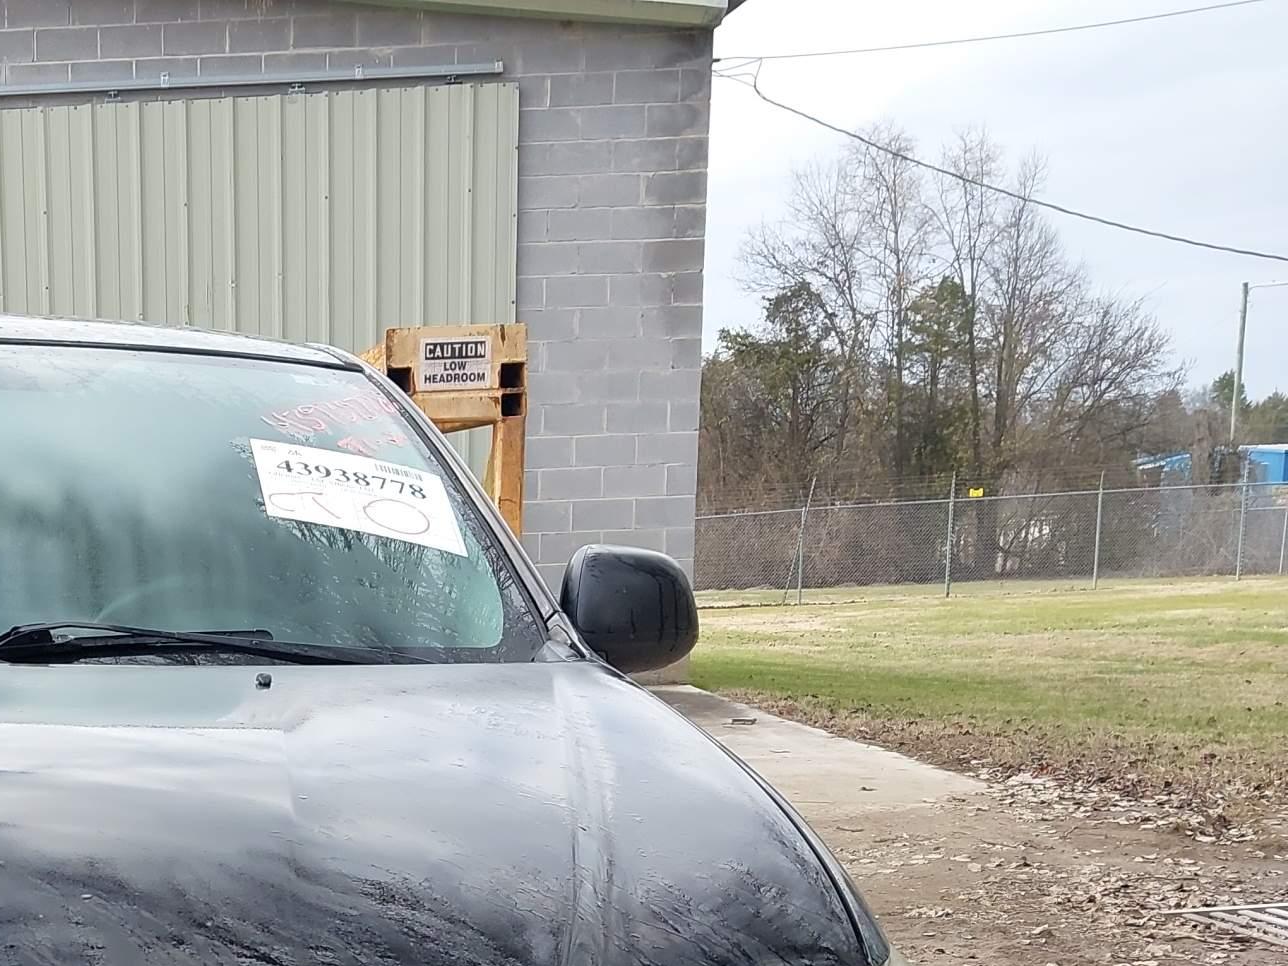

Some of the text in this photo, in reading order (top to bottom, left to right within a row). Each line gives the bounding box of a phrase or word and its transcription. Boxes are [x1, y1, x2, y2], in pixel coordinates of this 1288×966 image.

[425, 342, 486, 358] CAUTION
[443, 360, 468, 372] LOW
[423, 372, 486, 384] HEADROOM
[276, 459, 428, 500] 43938778
